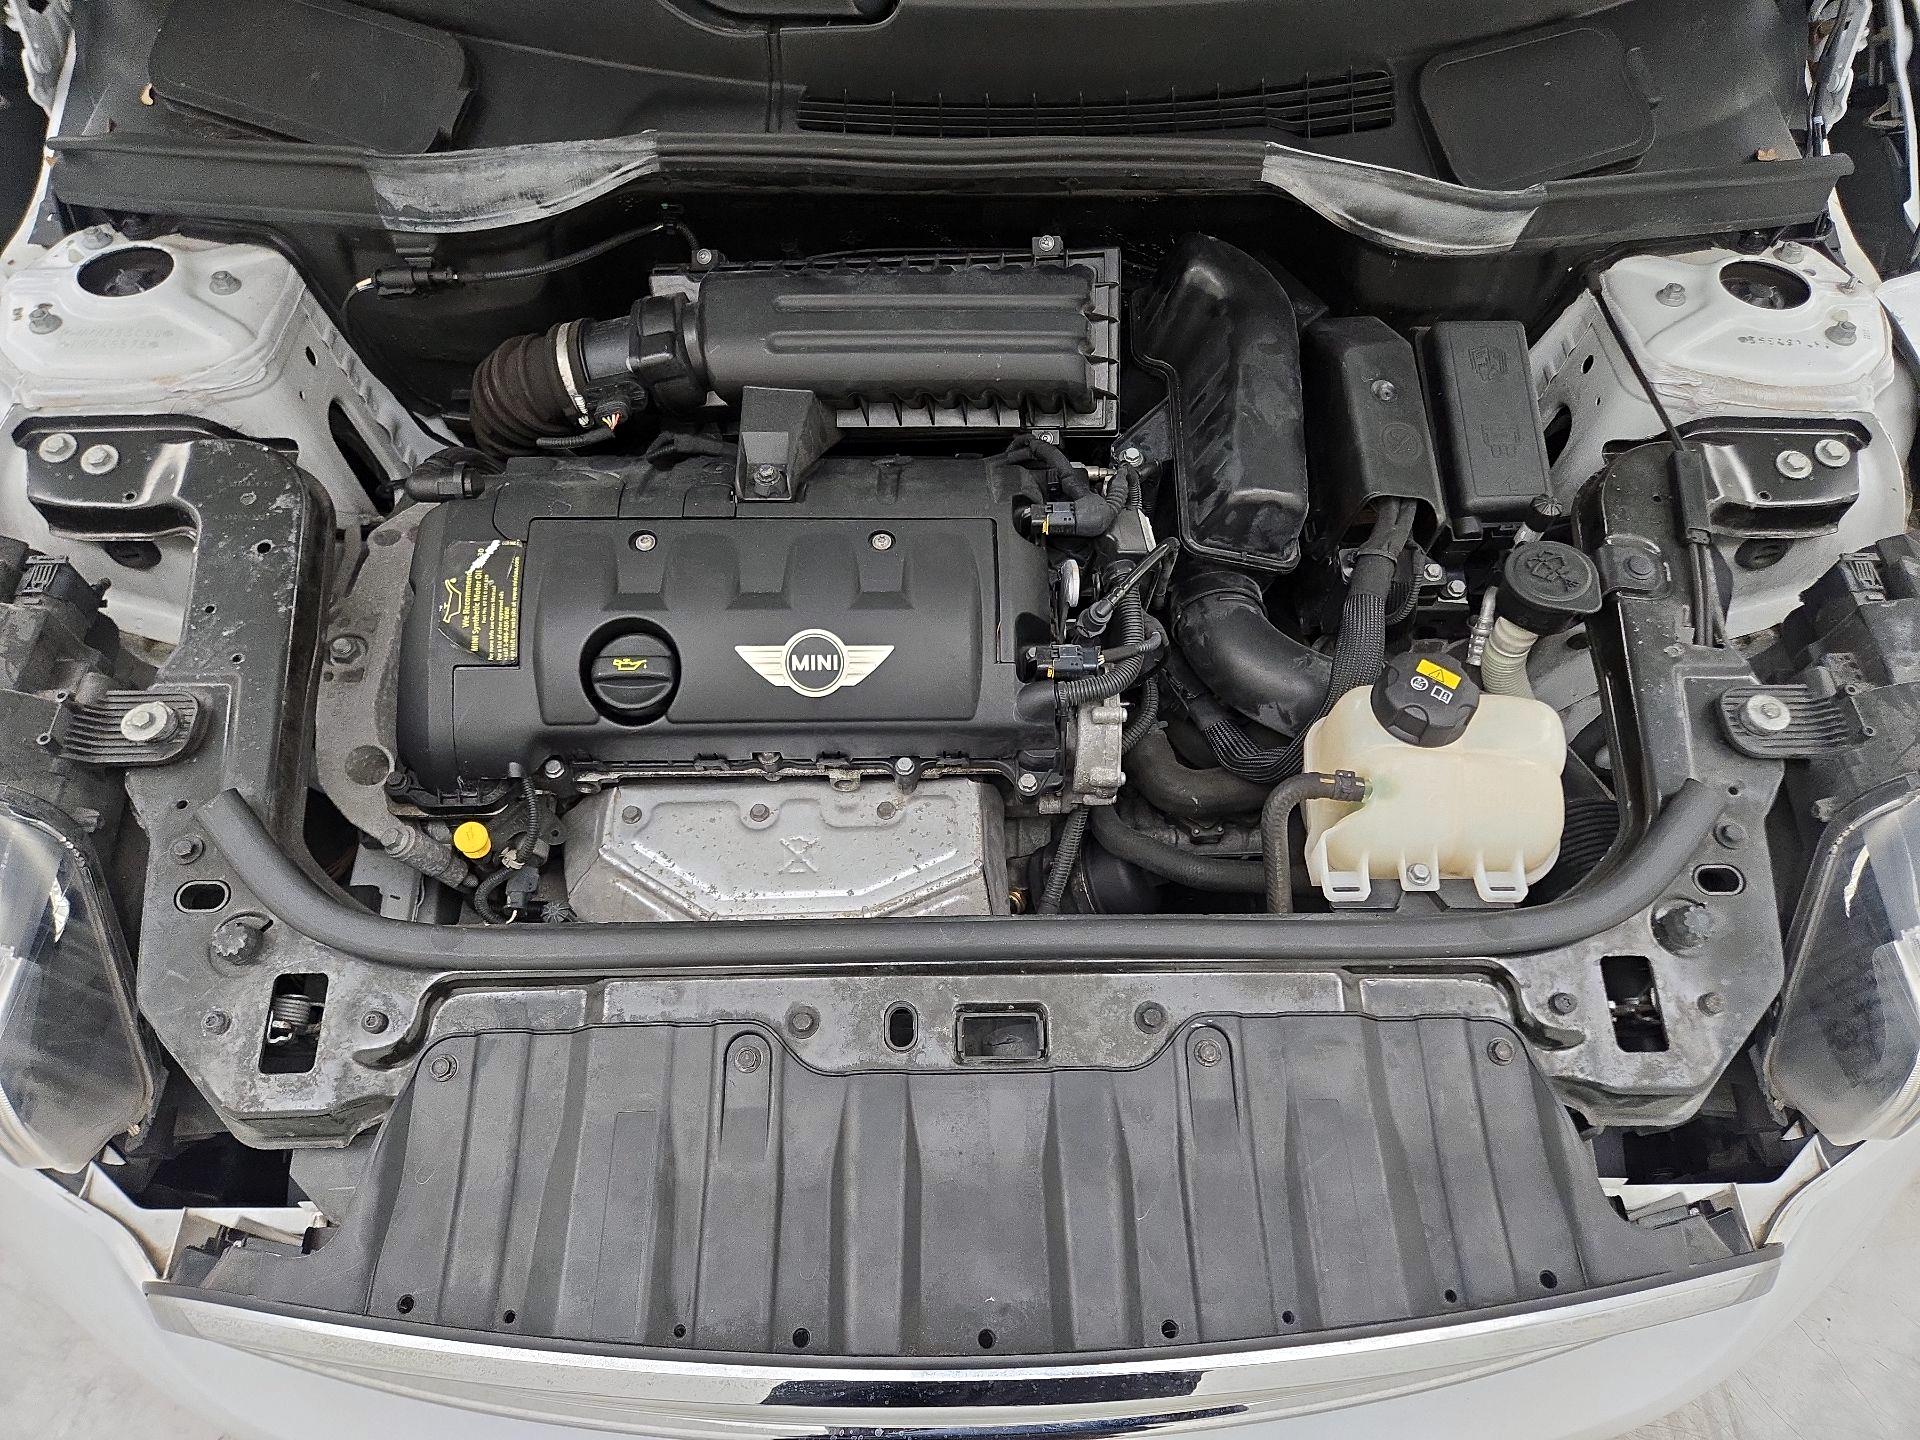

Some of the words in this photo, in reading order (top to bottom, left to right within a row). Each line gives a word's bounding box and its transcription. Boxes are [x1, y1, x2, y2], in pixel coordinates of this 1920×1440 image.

[474, 580, 482, 602] Motor
[462, 615, 470, 628] We
[472, 602, 481, 634] Synthetic
[791, 654, 839, 672] MINI
